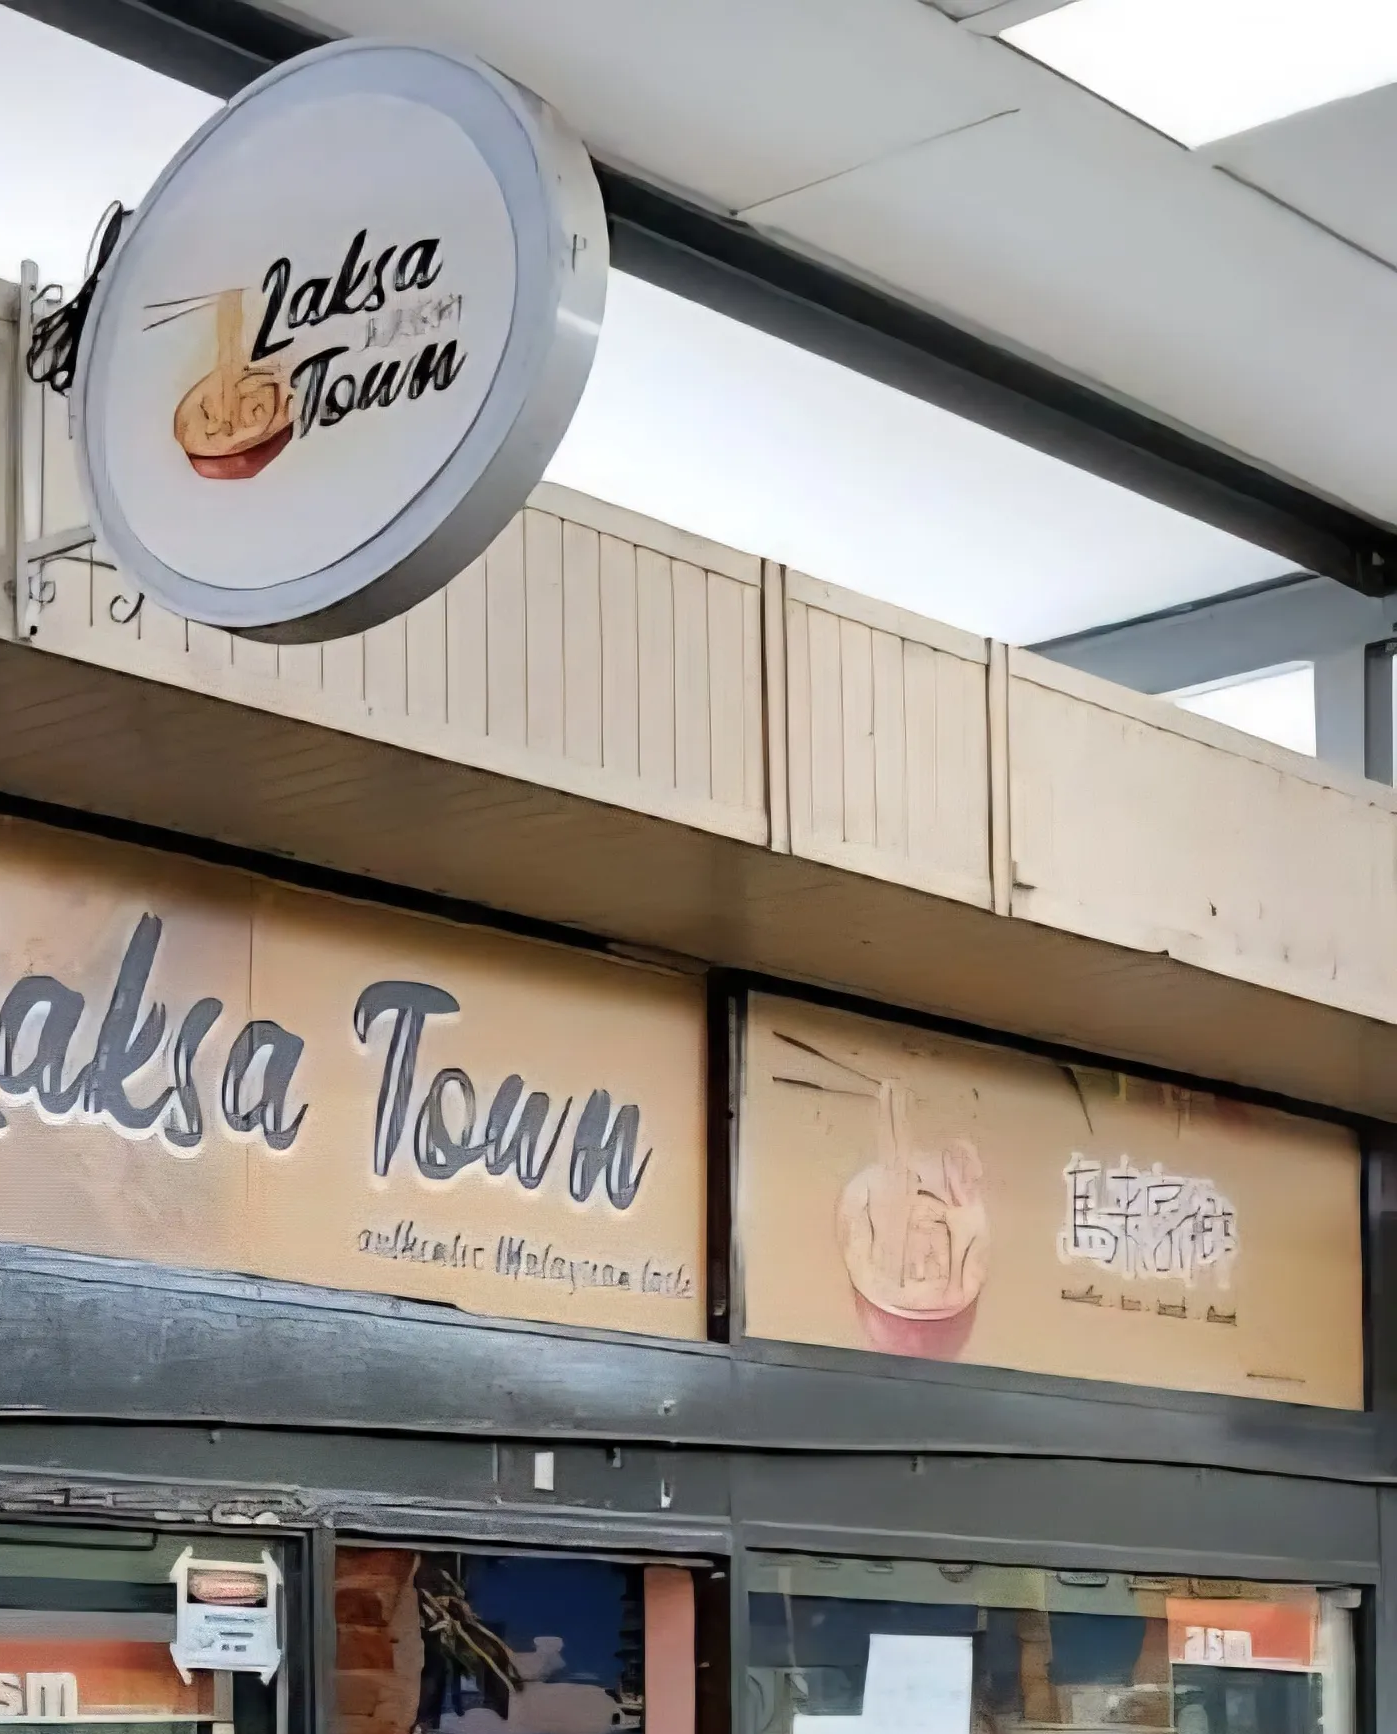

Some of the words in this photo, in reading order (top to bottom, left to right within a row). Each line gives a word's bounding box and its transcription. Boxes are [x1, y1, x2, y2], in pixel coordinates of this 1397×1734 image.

[250, 229, 444, 361] Laksa
[290, 339, 467, 439] Town
[355, 980, 654, 1210] Town
